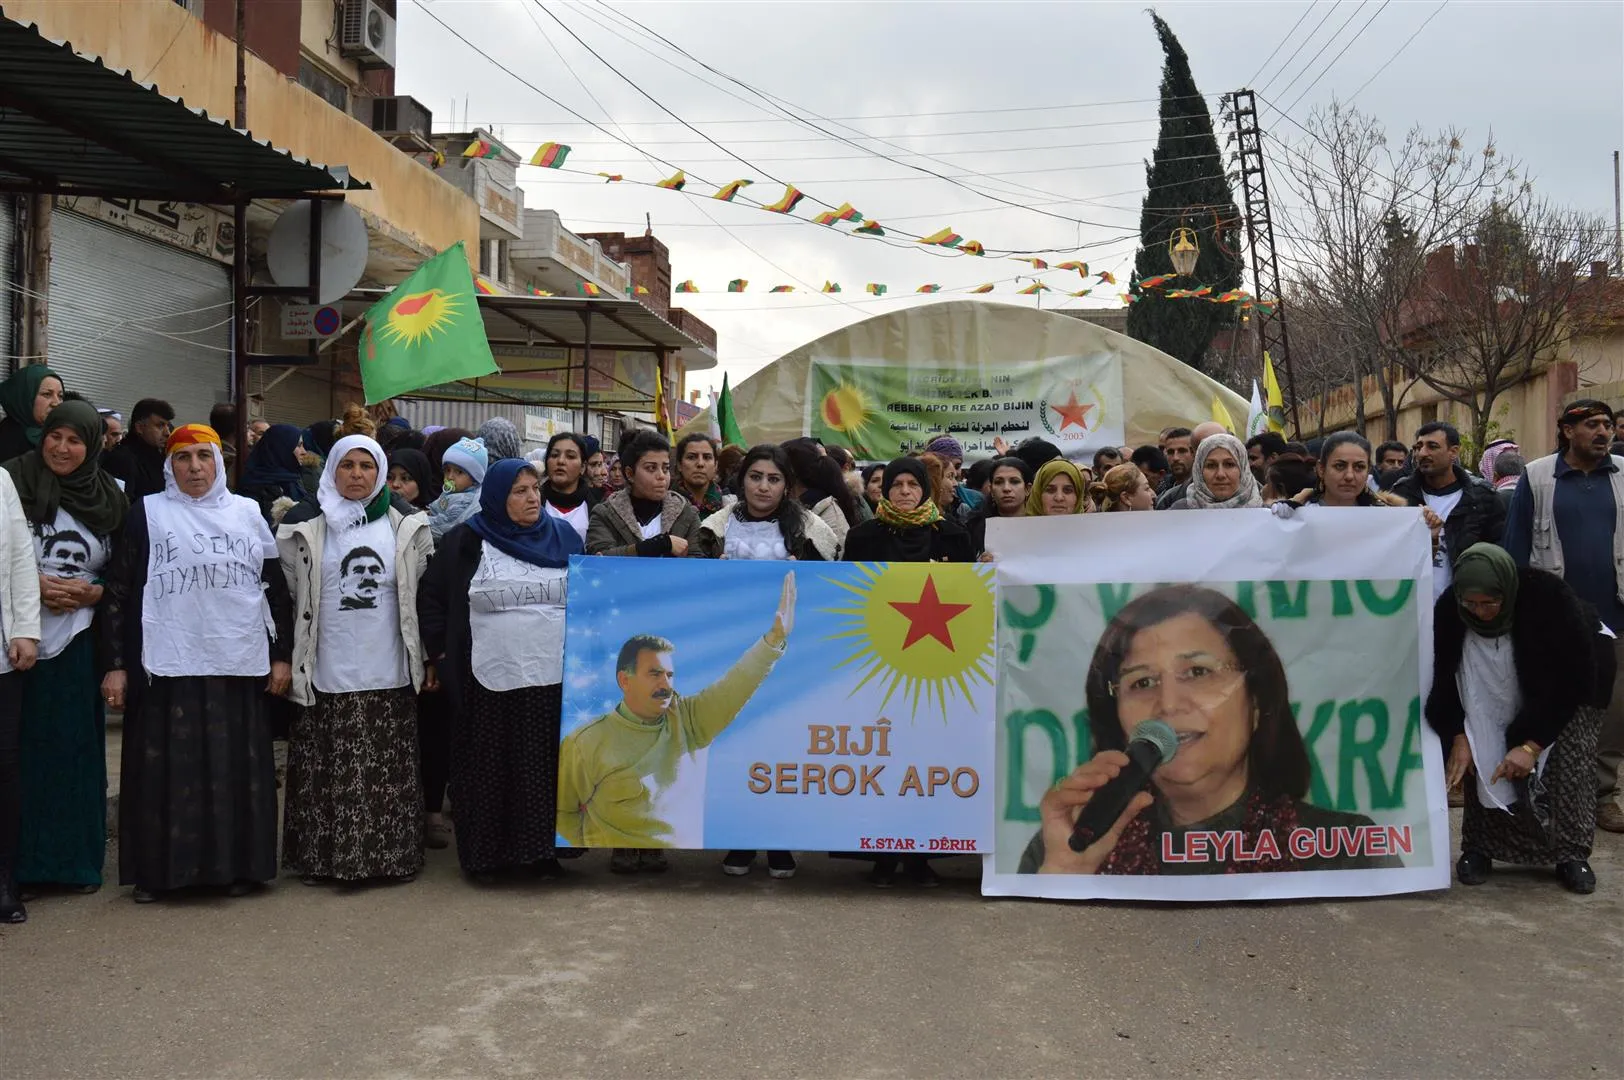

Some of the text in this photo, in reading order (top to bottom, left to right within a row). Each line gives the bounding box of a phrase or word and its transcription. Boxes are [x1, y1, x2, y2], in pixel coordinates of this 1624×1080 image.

[886, 401, 1034, 413] REBER APO RE AZAD BIJIN
[971, 420, 998, 435] العزلة
[1001, 420, 1030, 434] لنحطم
[1063, 432, 1084, 441] 2003
[152, 562, 218, 601] JIYAN
[807, 717, 892, 756] BIJÎ
[748, 762, 980, 798] SEROK APO
[860, 837, 915, 850] K.STAR
[929, 836, 977, 851] DÊRIK
[1161, 825, 1414, 863] LEYLA GUVEN
